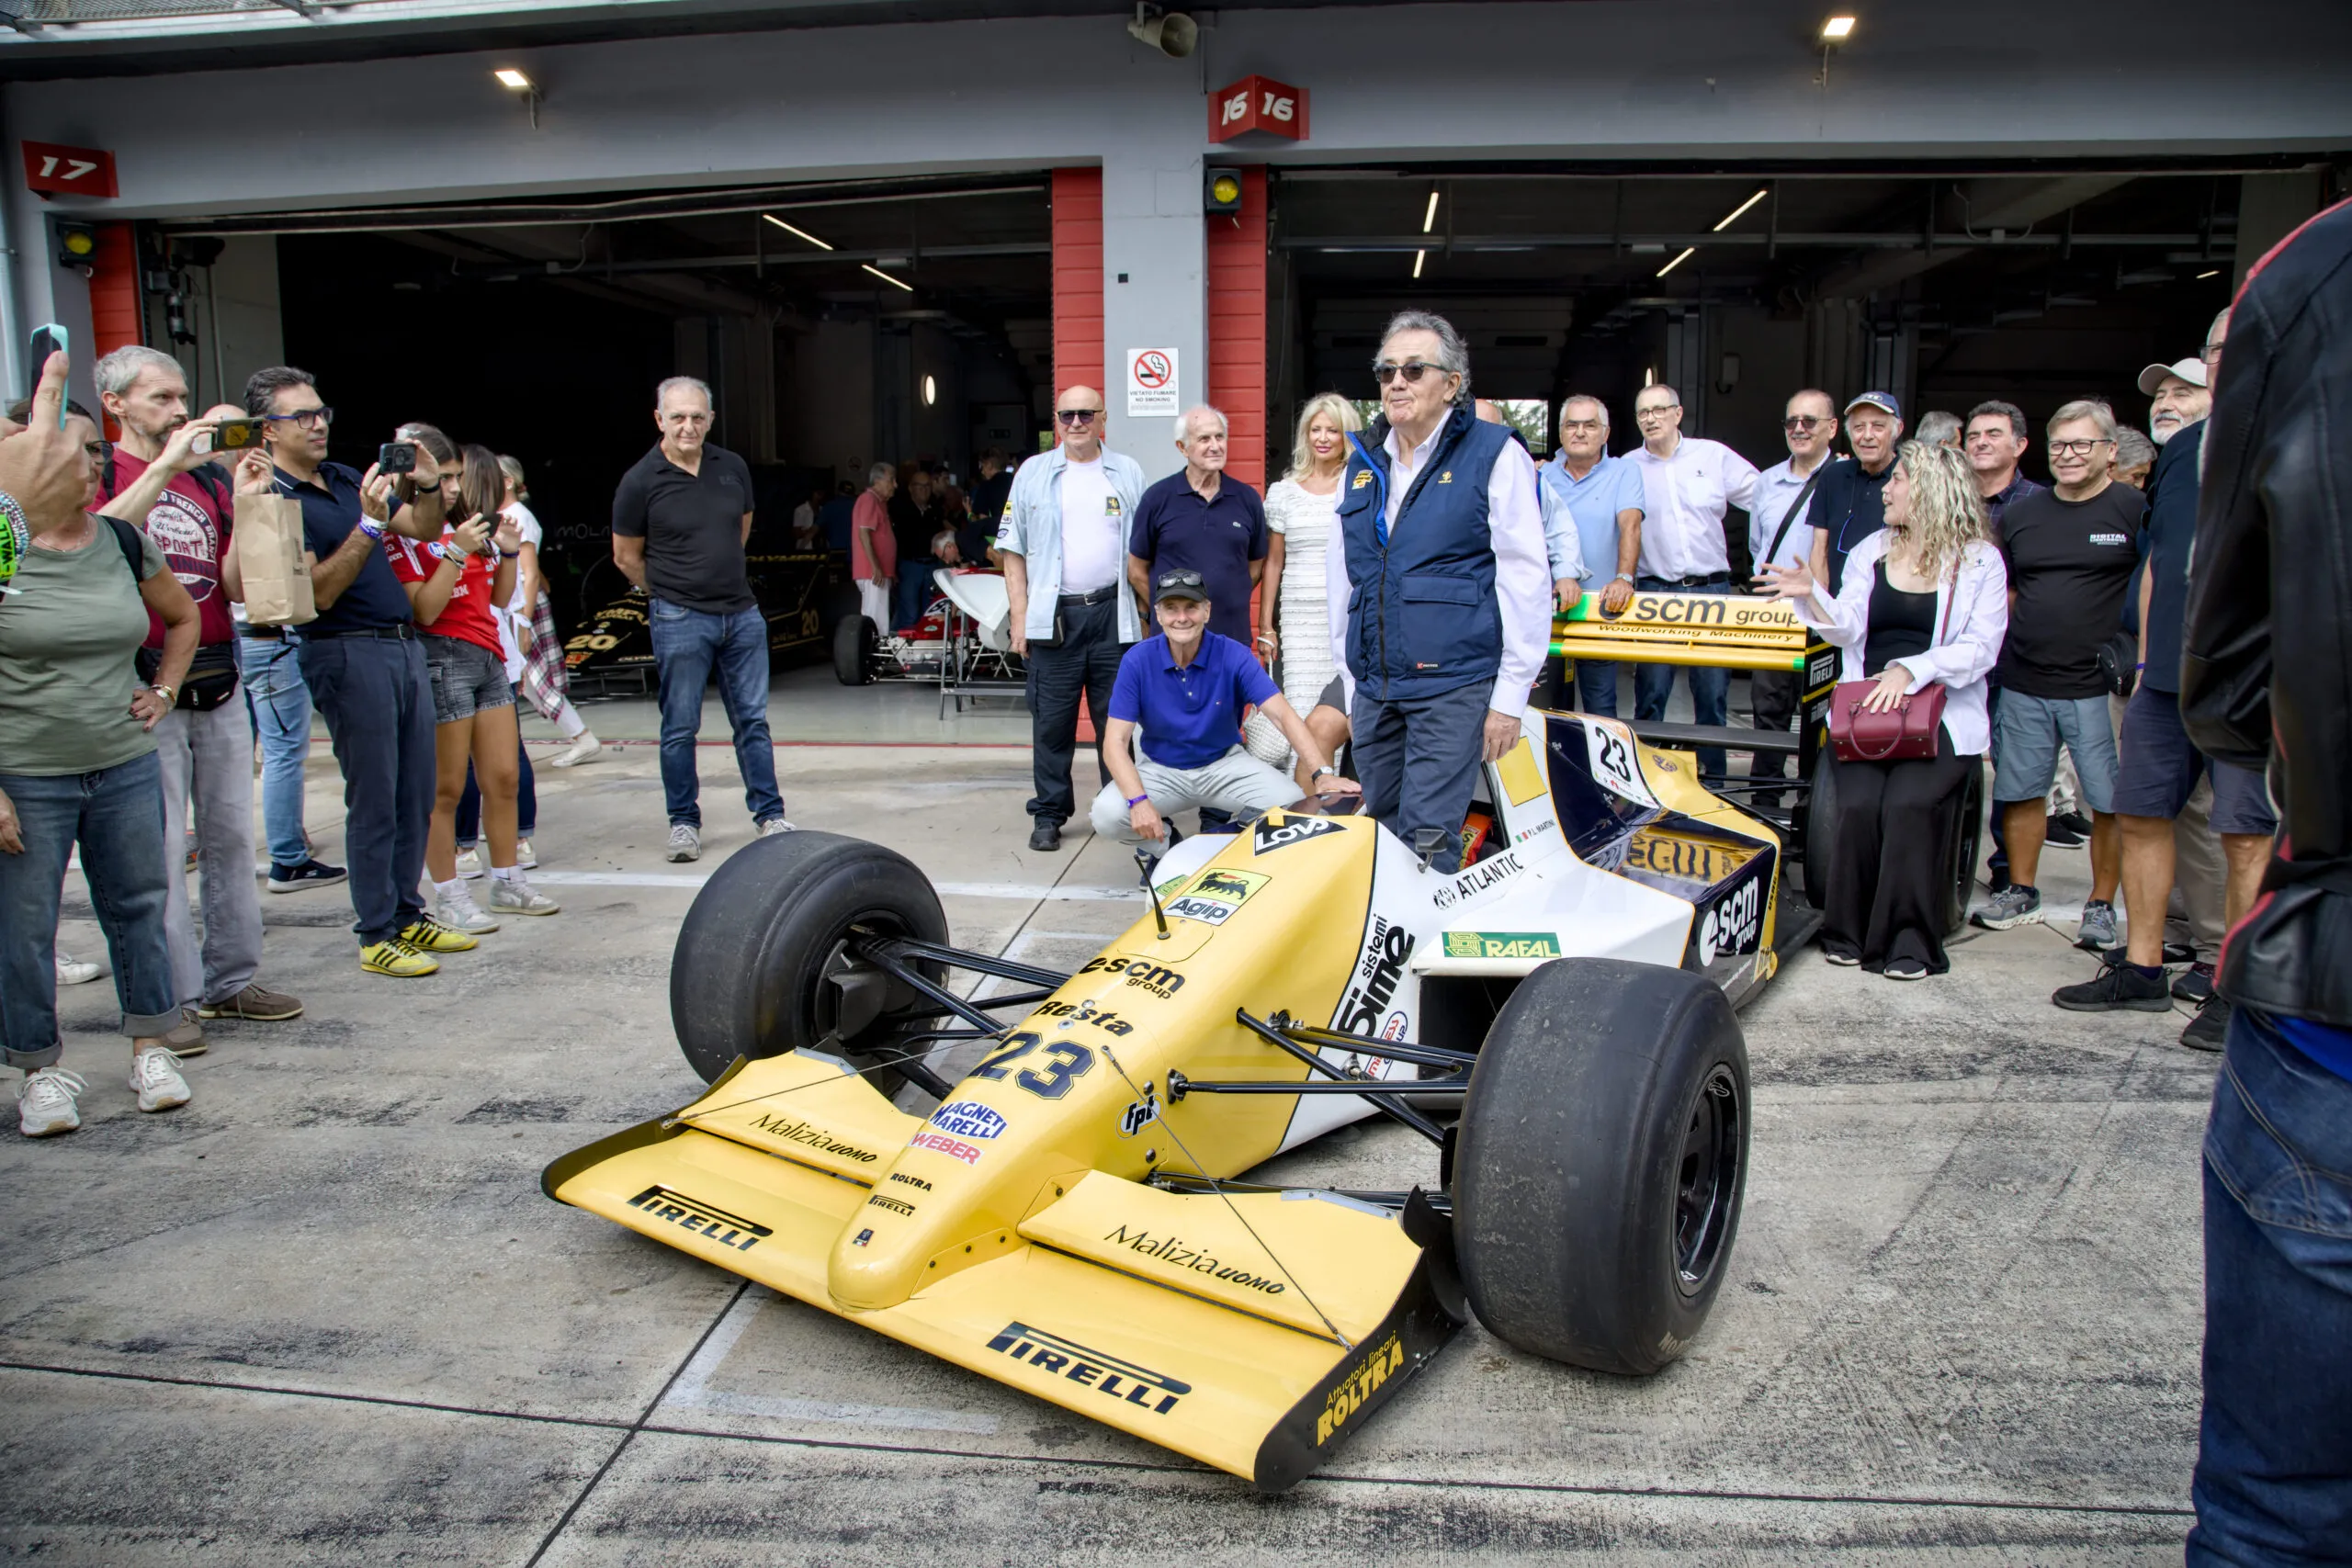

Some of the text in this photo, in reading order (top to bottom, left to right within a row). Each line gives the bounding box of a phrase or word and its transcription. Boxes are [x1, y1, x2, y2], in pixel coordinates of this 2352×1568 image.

[1221, 91, 1249, 126] 16
[1261, 92, 1295, 121] 16
[39, 155, 97, 180] 17
[1634, 597, 1801, 627] scm group
[564, 635, 618, 650] 20
[1598, 625, 1794, 642] Woodworking Machinery
[1595, 726, 1632, 782] 23
[1456, 852, 1523, 899] ATLANTIC
[1167, 897, 1228, 921] Agip
[1718, 875, 1758, 947] scm
[1362, 913, 1388, 979] sistemi
[1485, 940, 1562, 957] RAFAL
[1736, 919, 1757, 956] group
[1103, 958, 1185, 993] scm
[1125, 976, 1172, 1000] group
[1030, 1000, 1134, 1037] Resta
[965, 1030, 1096, 1100] 23
[930, 1102, 1008, 1129] MAGNETI
[930, 1112, 1003, 1139] MARELLI
[1125, 1095, 1157, 1135] fpt
[910, 1133, 982, 1166] WEBER
[890, 1172, 933, 1191] ROLTRA
[626, 1184, 774, 1251] PIRELLI
[868, 1194, 916, 1217] PIRELLI
[986, 1320, 1192, 1416] PIRELLI
[1326, 1329, 1396, 1409] Attuatori lineari
[1317, 1339, 1404, 1447] ROLTRA
